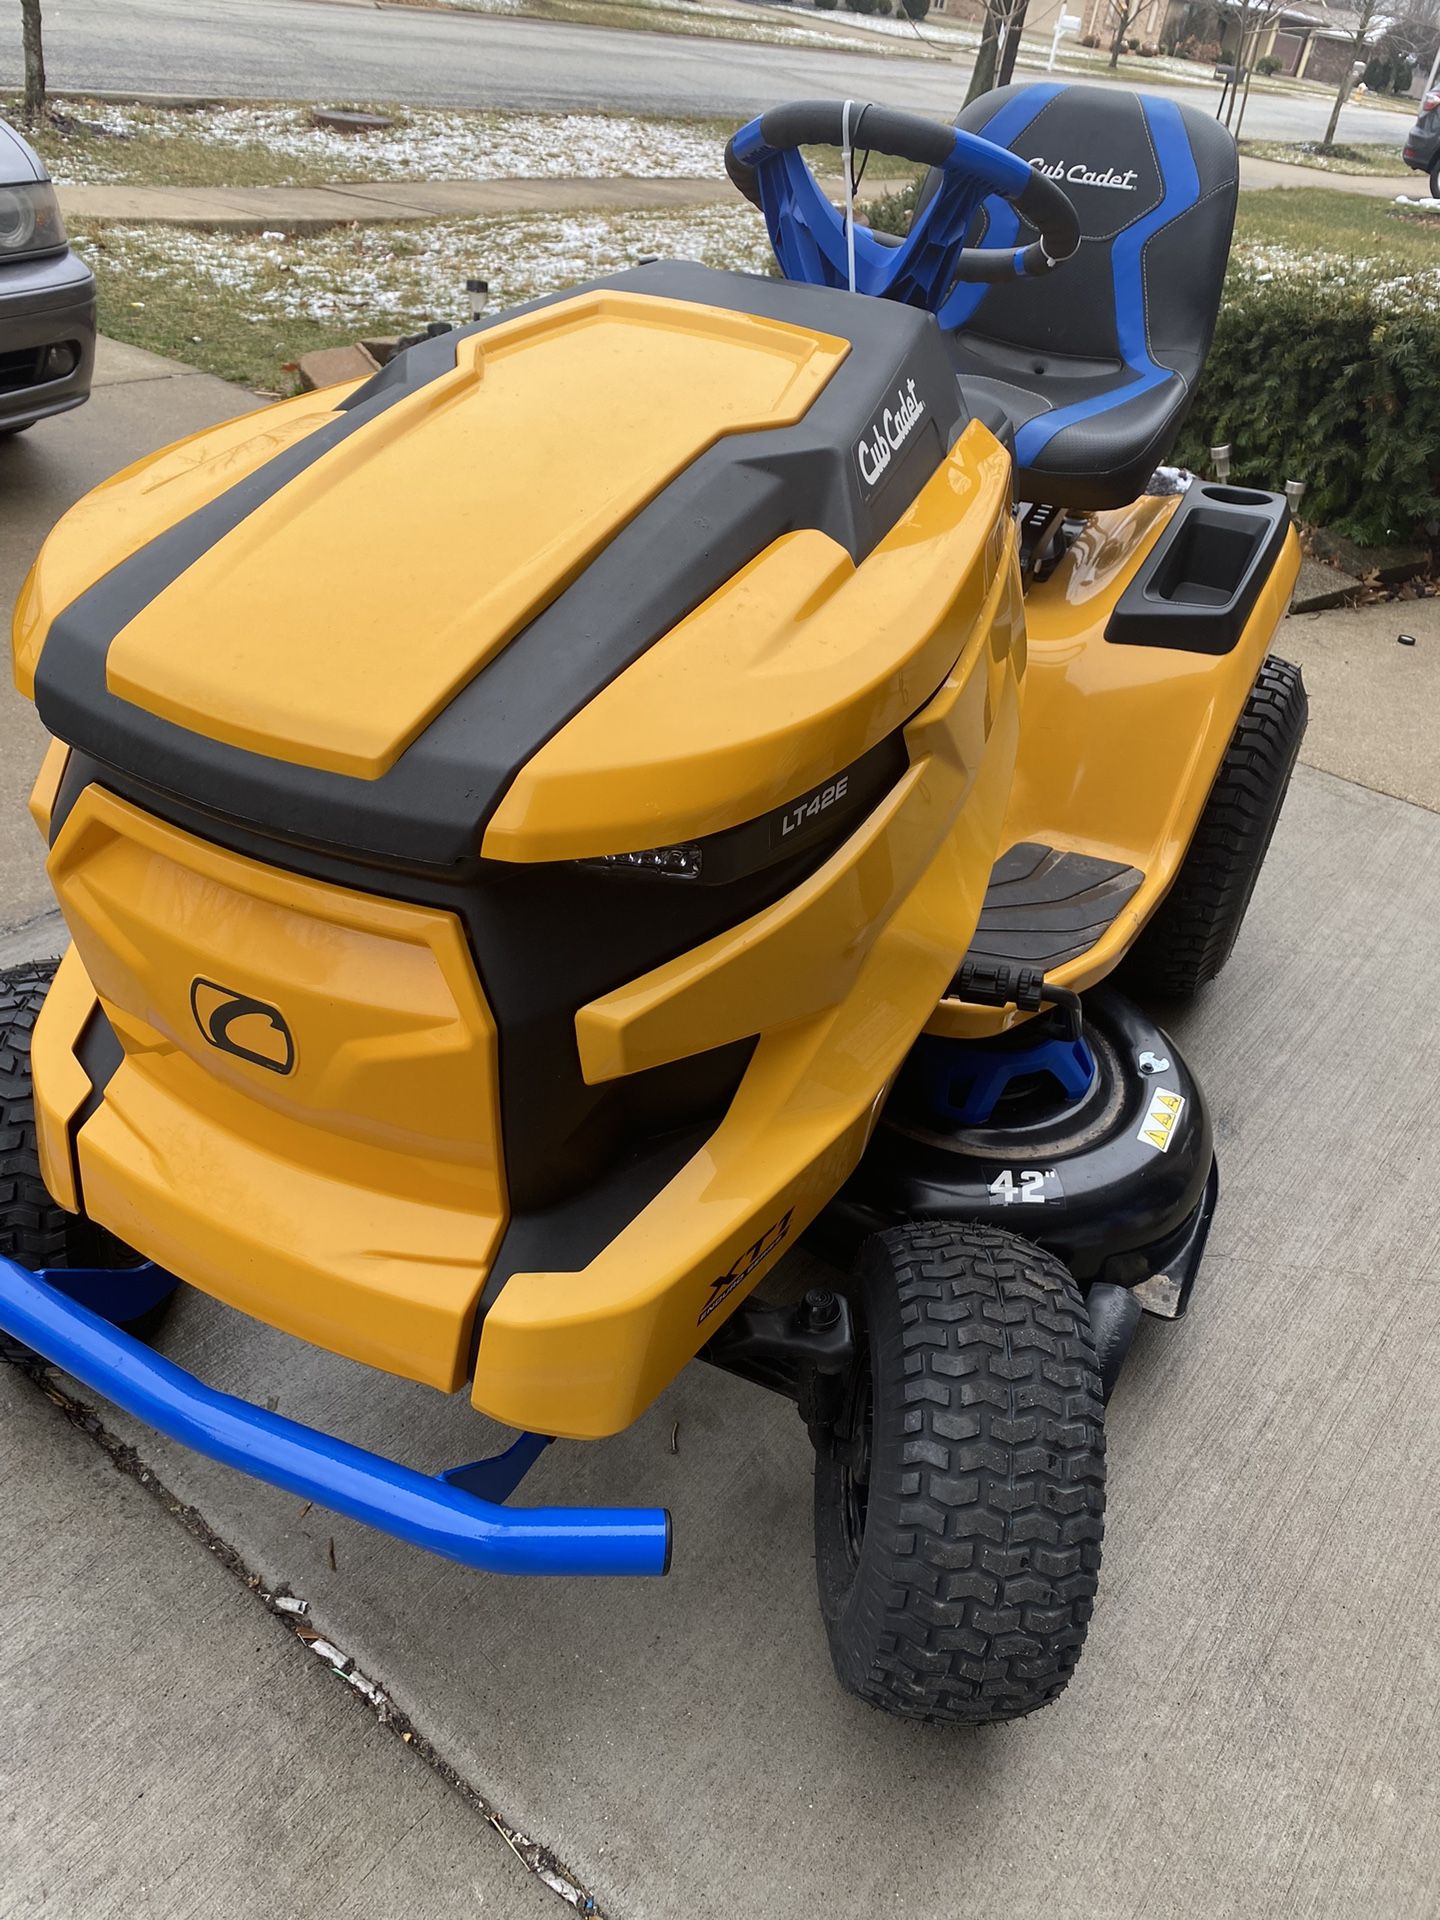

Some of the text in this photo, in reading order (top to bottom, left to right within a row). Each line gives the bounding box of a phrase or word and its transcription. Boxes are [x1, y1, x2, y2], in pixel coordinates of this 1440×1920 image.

[1066, 164, 1138, 190] Cadet
[858, 378, 924, 485] Cub Cadet
[782, 775, 849, 836] LT42E
[990, 1170, 1056, 1204] 42"
[700, 1205, 796, 1311] XT1
